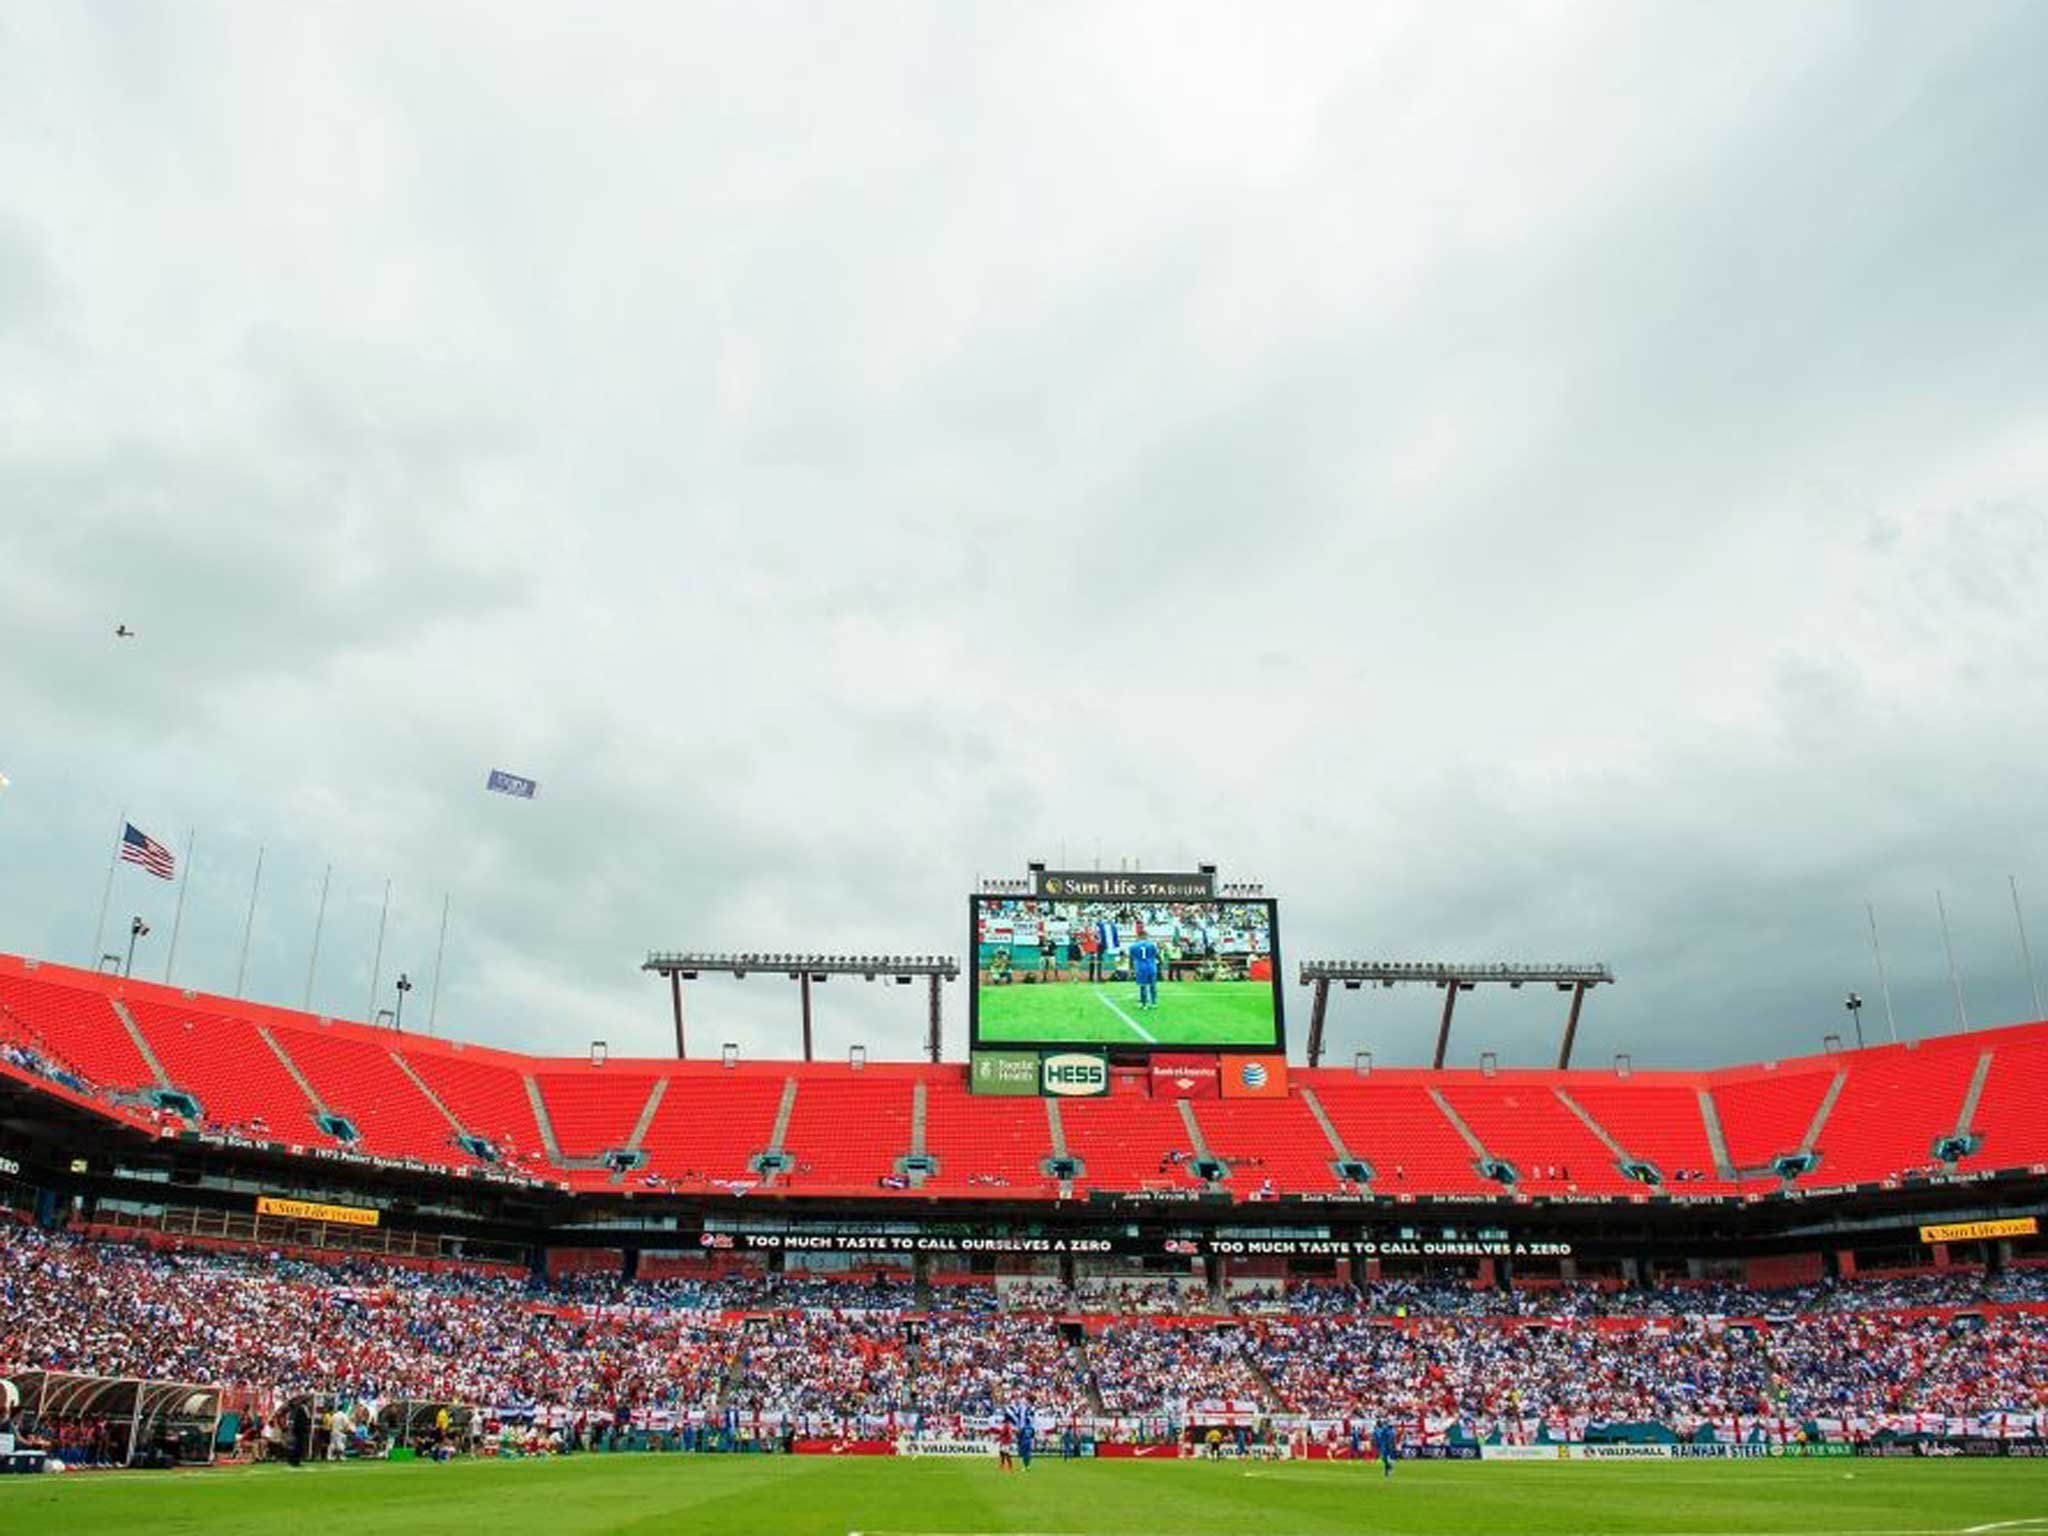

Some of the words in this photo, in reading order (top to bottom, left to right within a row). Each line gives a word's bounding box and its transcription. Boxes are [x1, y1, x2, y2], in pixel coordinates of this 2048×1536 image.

[1064, 879, 1099, 894] Sun
[1104, 879, 1137, 894] Life
[1142, 884, 1206, 896] STADIUM
[1047, 1065, 1101, 1083] HESS
[745, 1235, 779, 1247] TOO
[784, 1236, 832, 1248] MUCH
[836, 1237, 886, 1248] TASTE
[892, 1237, 913, 1248] TO
[918, 1238, 957, 1249] CALL
[962, 1239, 1049, 1250] OURSELVES
[1054, 1239, 1067, 1250] A
[1070, 1240, 1111, 1251] ZERO
[1209, 1242, 1244, 1253] TOO
[1248, 1242, 1295, 1253] MUCH
[1299, 1242, 1349, 1253] TASTE
[1354, 1242, 1376, 1253] TO
[1381, 1243, 1420, 1254] CALL
[1423, 1243, 1511, 1255] OURSELVES
[1515, 1244, 1528, 1255] A
[1530, 1244, 1571, 1255] ZERO
[921, 1444, 988, 1454] VAUXHALL
[1598, 1446, 1665, 1456] VAUXHALL
[1731, 1445, 1766, 1457] STEEL
